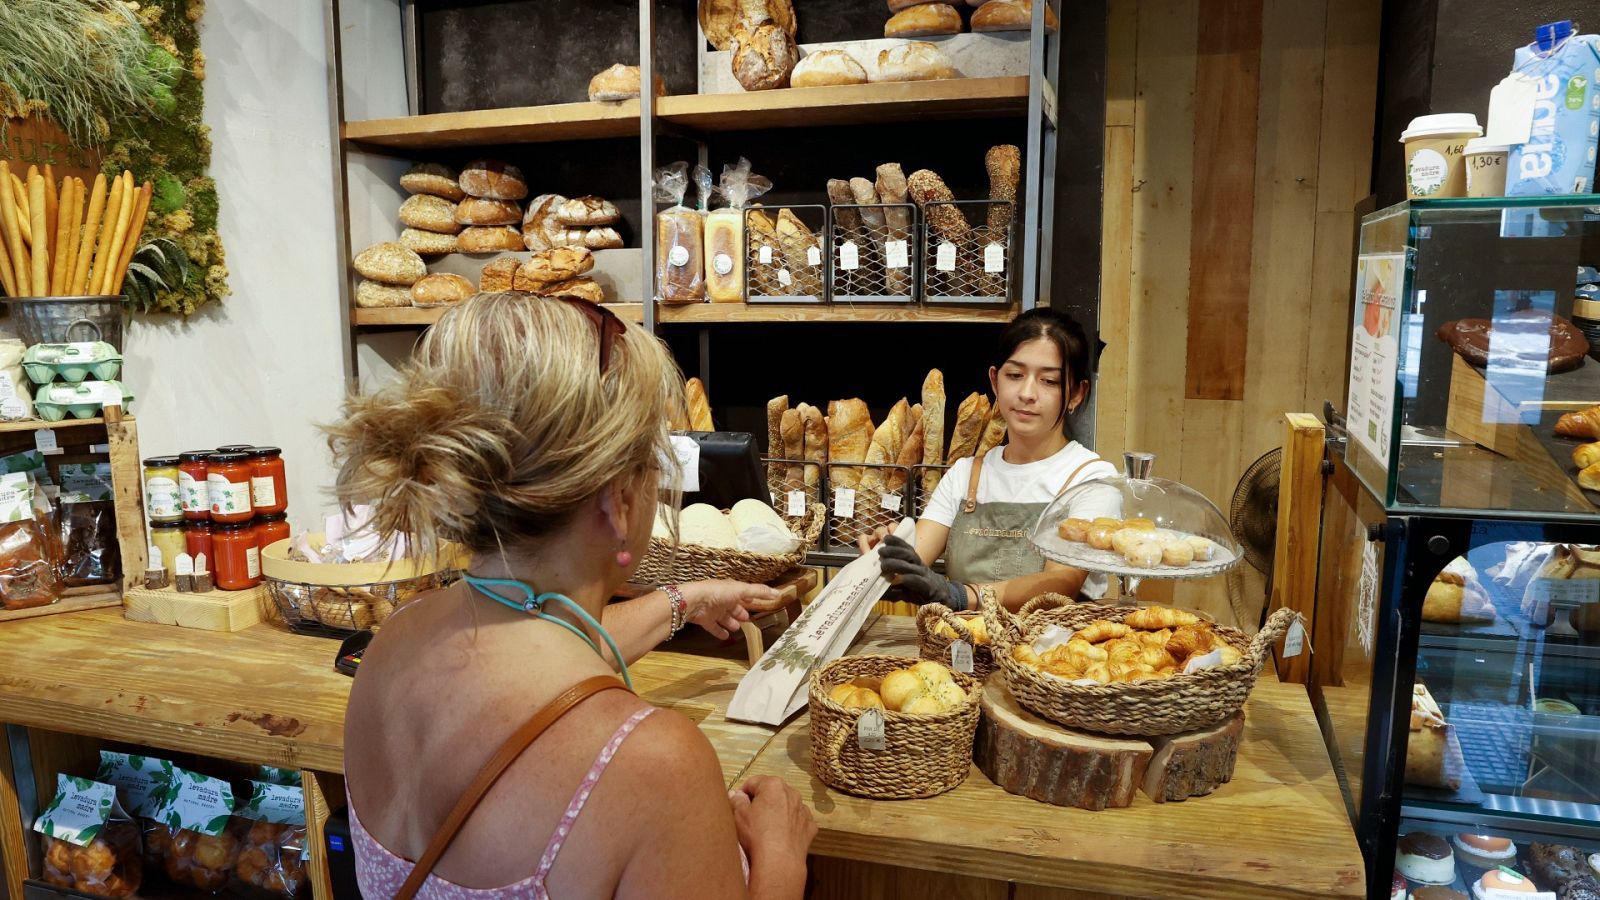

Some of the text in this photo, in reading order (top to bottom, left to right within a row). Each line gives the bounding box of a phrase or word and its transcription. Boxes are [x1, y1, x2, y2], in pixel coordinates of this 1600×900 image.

[1445, 144, 1464, 157] 1,60
[187, 782, 219, 797] levadura
[70, 791, 97, 806] levadura
[197, 794, 218, 804] madre
[270, 794, 303, 804] levadura
[76, 803, 94, 813] madre
